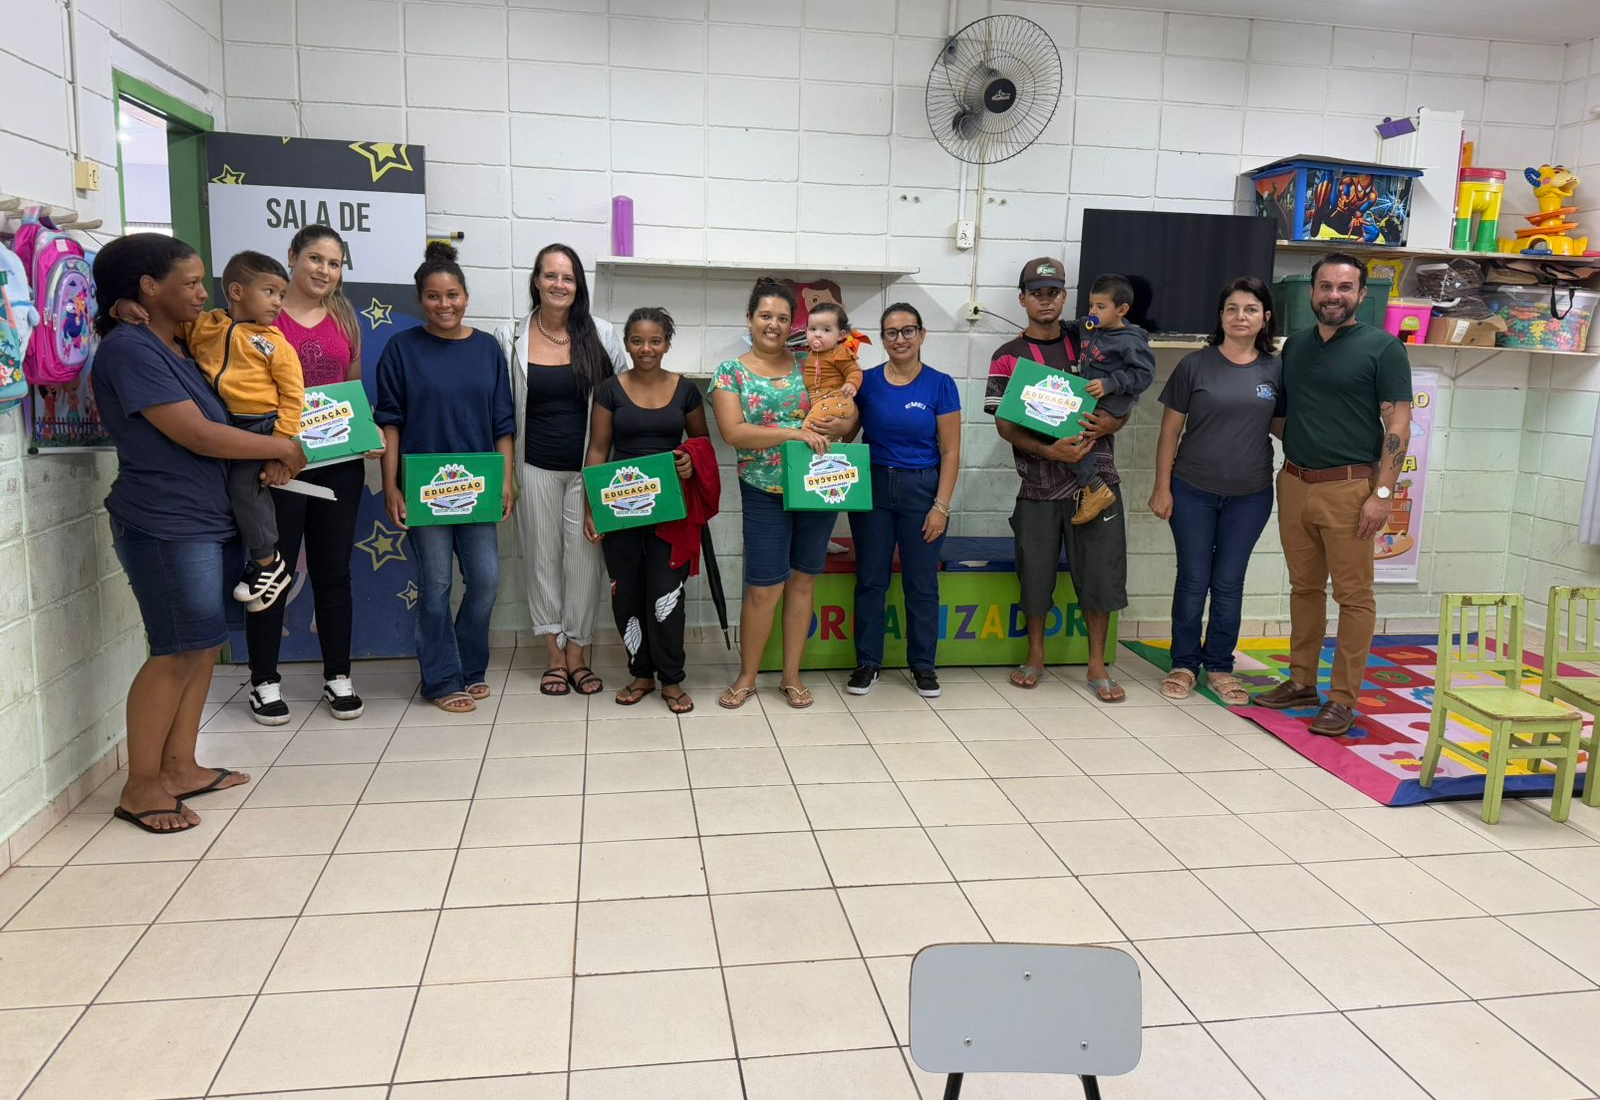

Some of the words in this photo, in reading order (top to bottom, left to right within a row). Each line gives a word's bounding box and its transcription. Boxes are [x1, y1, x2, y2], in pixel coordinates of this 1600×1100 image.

[266, 197, 332, 230] SALA
[339, 201, 371, 232] DE
[1026, 390, 1077, 408] EDUCAÇÃO
[300, 407, 349, 429] DUCAÇÃO
[808, 471, 855, 486] EDUCAÇÃO
[424, 481, 481, 498] EDUCAÇÃO
[604, 483, 656, 499] EDUCAÇÃO
